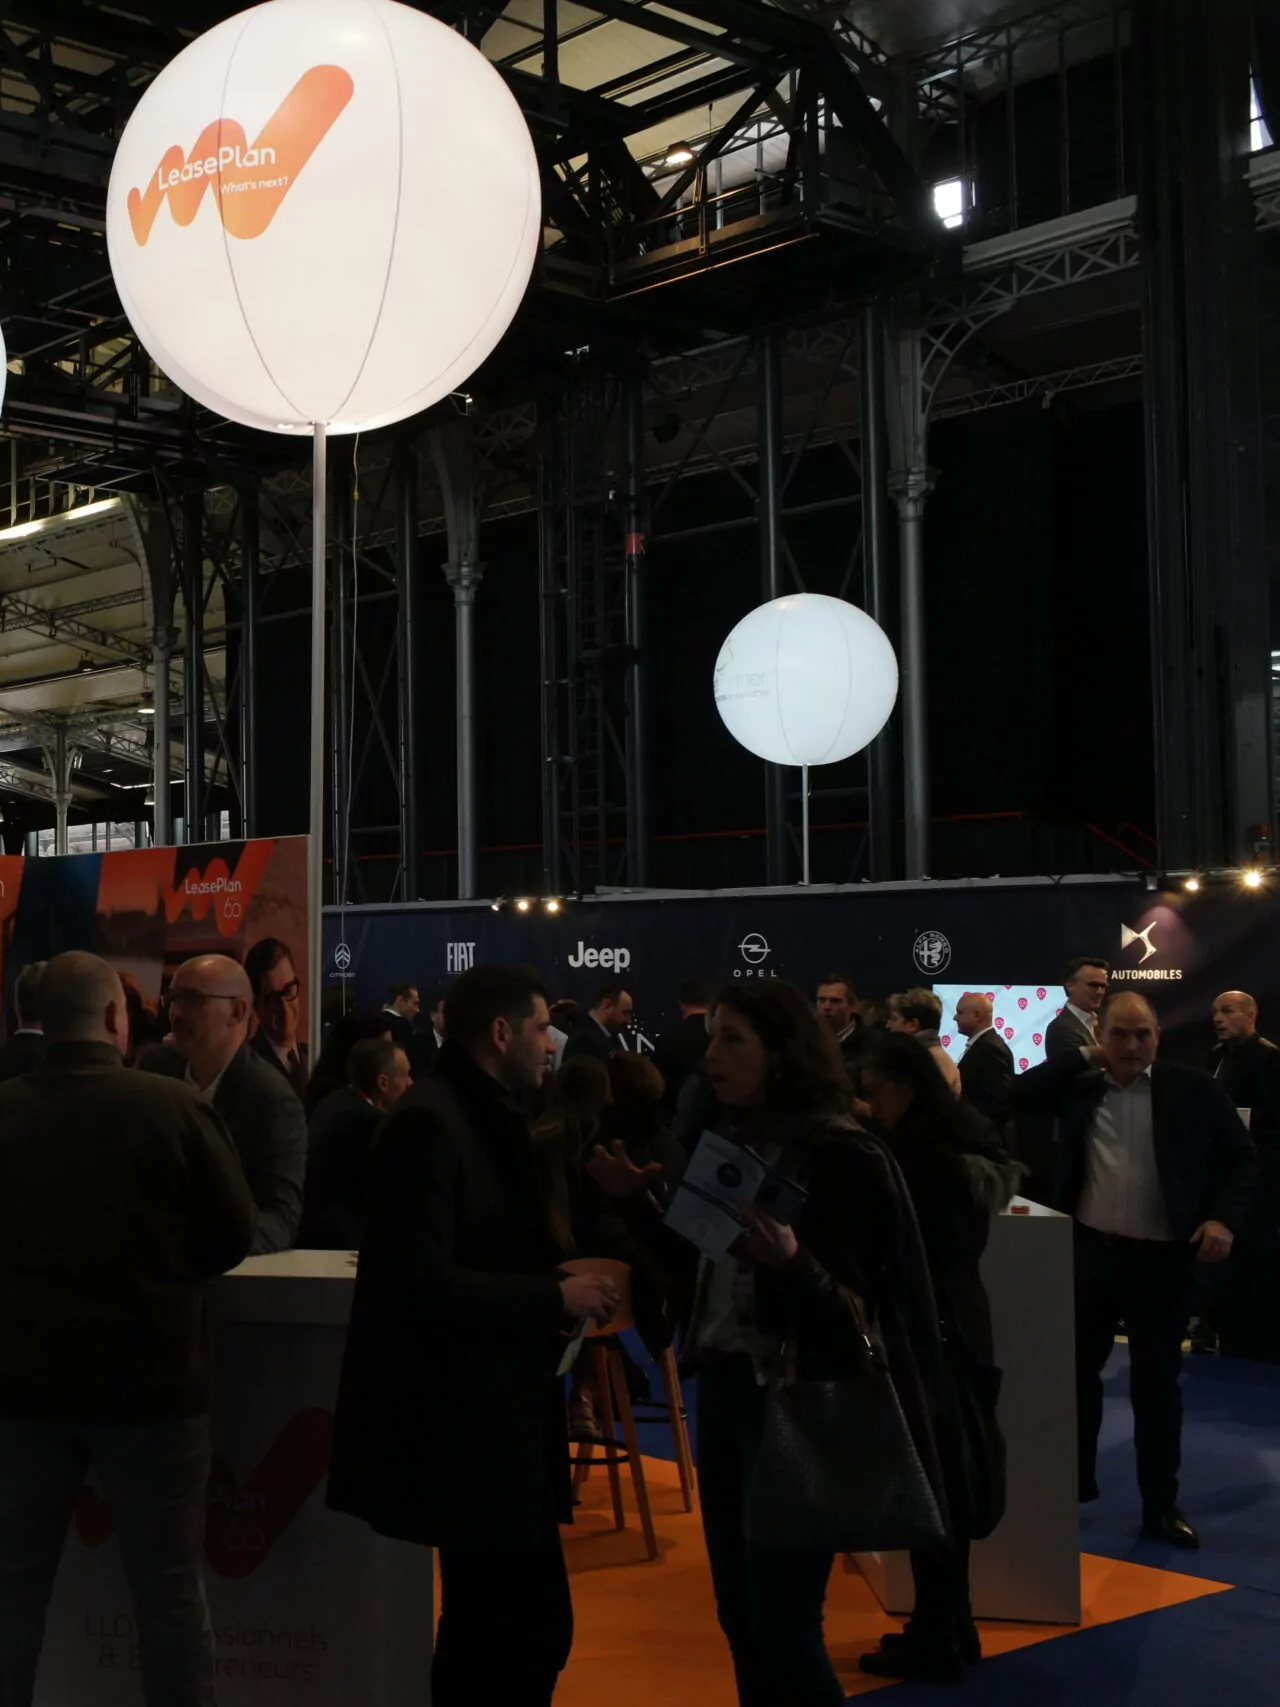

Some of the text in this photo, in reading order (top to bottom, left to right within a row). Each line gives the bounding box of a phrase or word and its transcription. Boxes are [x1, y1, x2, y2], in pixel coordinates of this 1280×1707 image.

[158, 146, 276, 190] LeasePlan
[221, 176, 289, 194] What's next?
[185, 877, 242, 894] LeasePlan
[447, 942, 476, 971] FIAT
[568, 941, 631, 973] Jeep
[733, 969, 778, 978] OPEL
[1111, 969, 1183, 980] AUTOMOBILES
[86, 1612, 133, 1638] LLD
